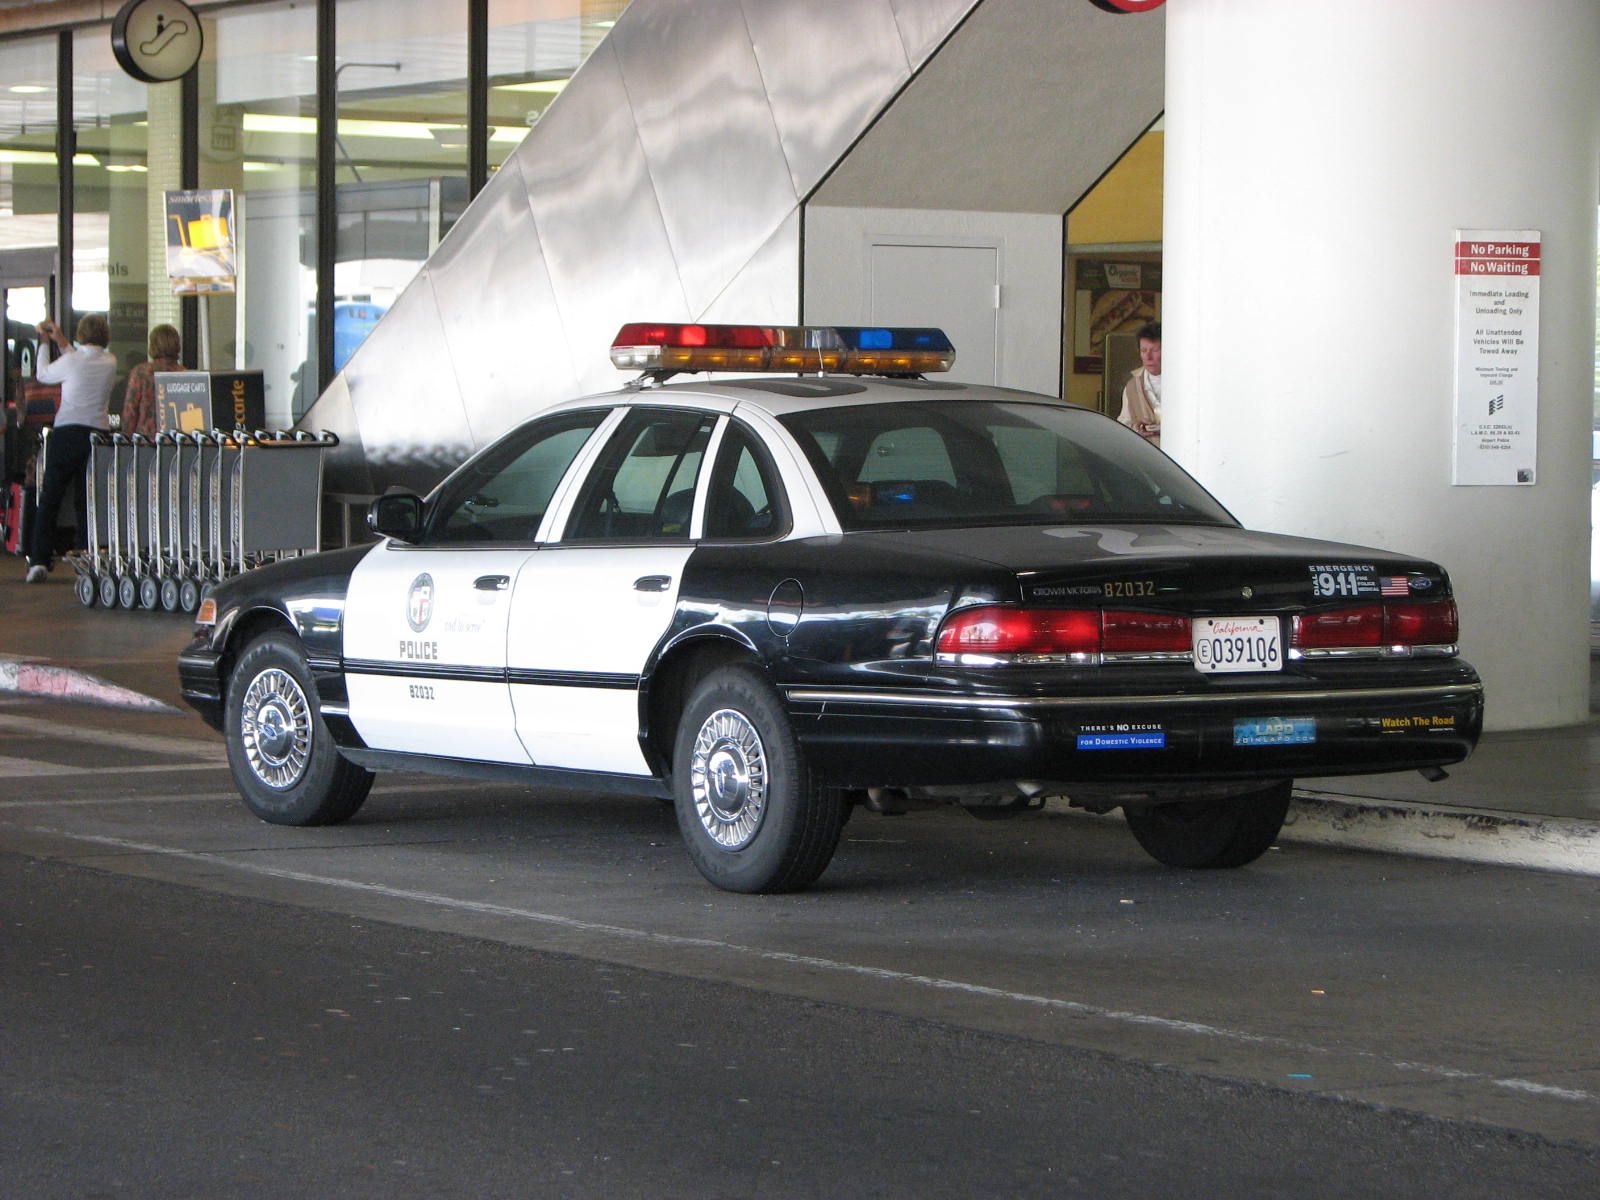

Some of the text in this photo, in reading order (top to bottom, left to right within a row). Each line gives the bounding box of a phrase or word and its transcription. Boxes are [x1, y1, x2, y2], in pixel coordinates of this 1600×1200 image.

[1471, 244, 1529, 257] No Parking
[1470, 262, 1528, 275] No Waiting
[1505, 290, 1529, 298] Loading
[166, 383, 206, 393] LUGGAGE CARTS
[1104, 581, 1156, 597] 82032
[1312, 574, 1320, 596] DIAL
[1213, 622, 1264, 635] California
[399, 640, 438, 660] POLICE
[1212, 637, 1278, 663] 039106
[409, 684, 436, 700] 82032
[1381, 716, 1455, 727] Watch The Road
